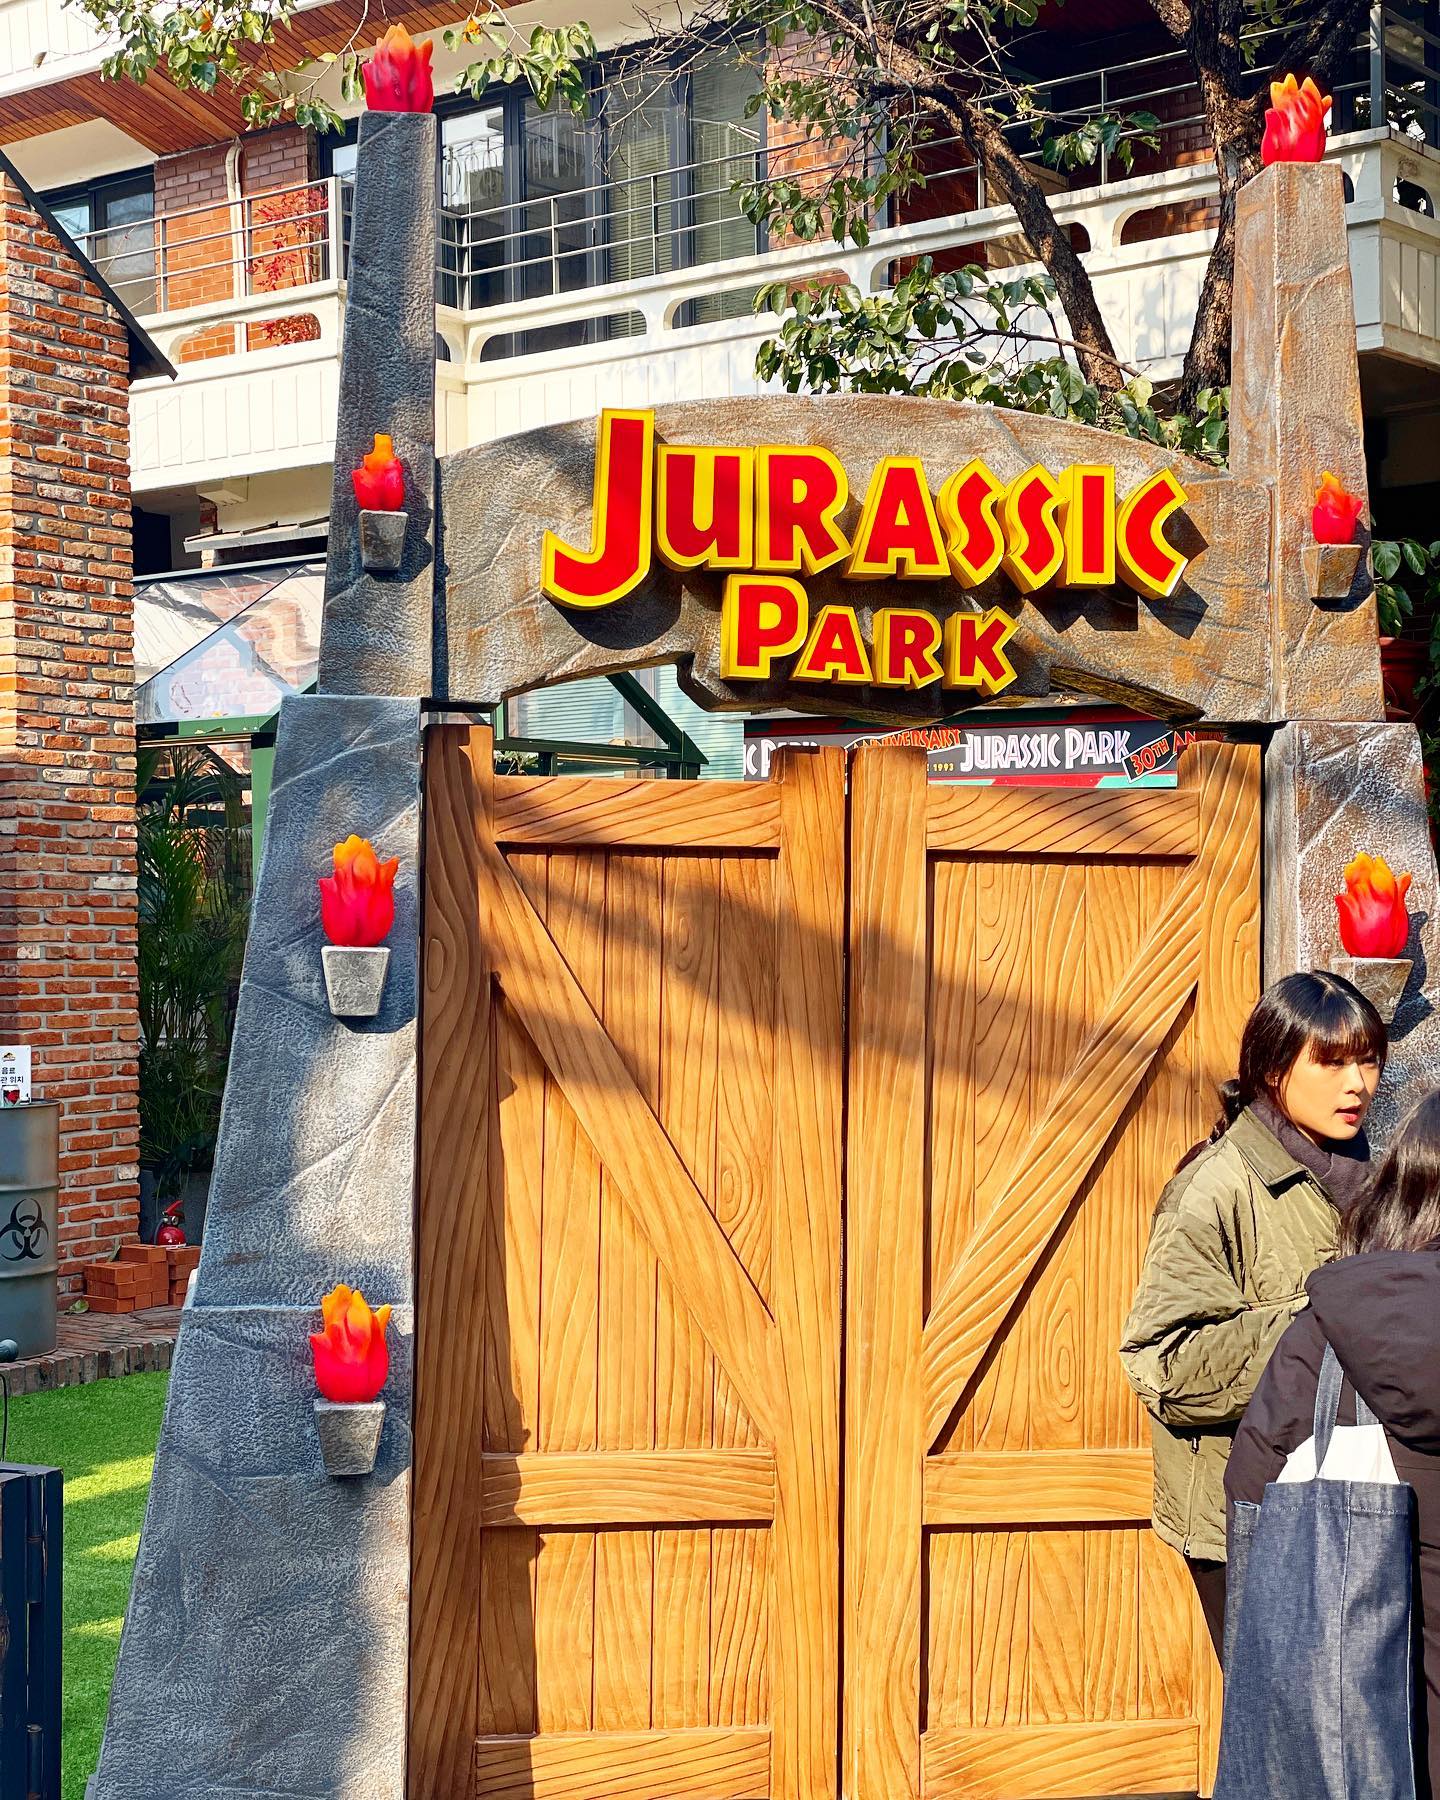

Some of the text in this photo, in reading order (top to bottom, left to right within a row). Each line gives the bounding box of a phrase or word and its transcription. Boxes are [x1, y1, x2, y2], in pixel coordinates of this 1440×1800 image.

[541, 408, 1189, 608] JURASSIC
[721, 574, 1019, 695] PARK
[933, 763, 954, 772] 1993
[960, 732, 1060, 772] JURASSIC
[1065, 728, 1131, 769] PARK
[1130, 737, 1170, 775] 30TH
